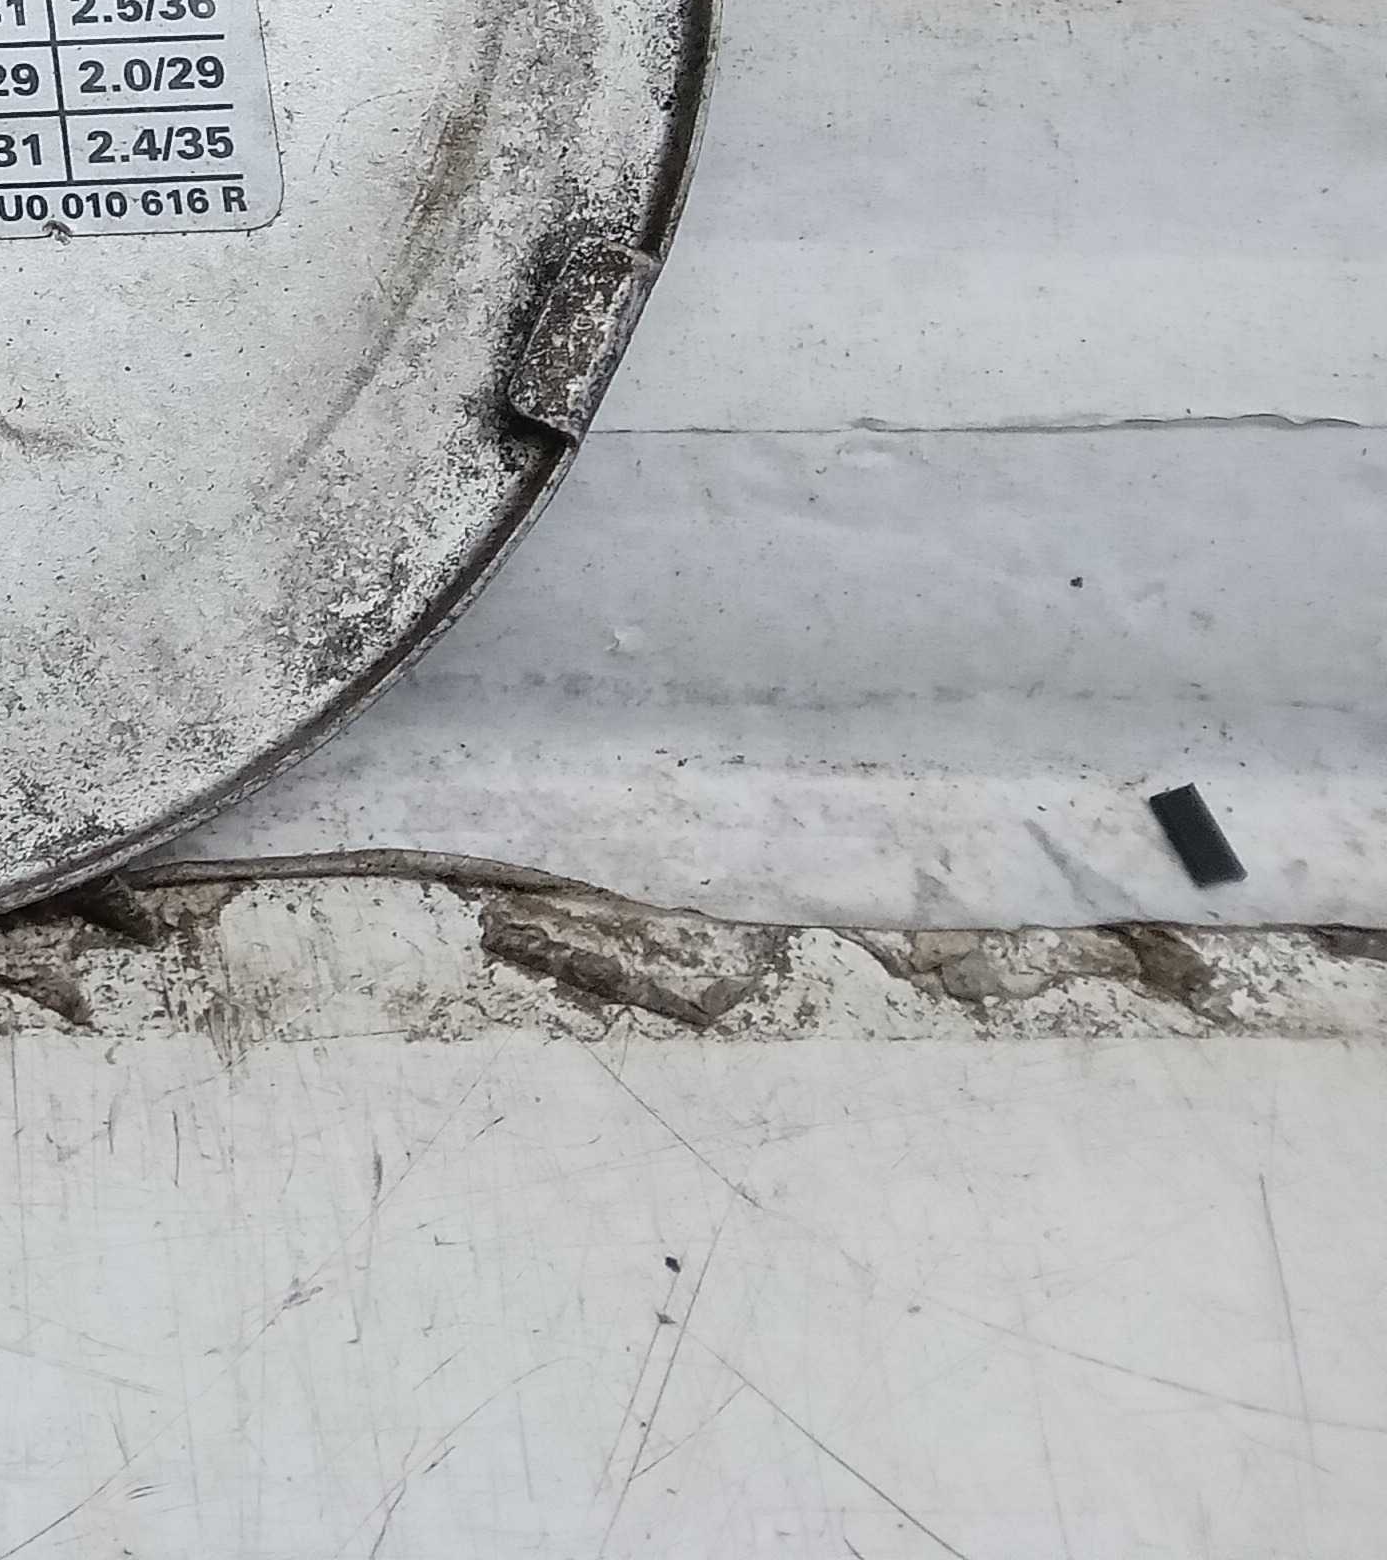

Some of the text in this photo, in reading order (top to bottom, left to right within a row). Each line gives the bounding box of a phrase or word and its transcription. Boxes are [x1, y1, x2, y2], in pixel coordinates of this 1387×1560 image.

[79, 56, 225, 93] 2.0/29
[87, 126, 234, 163] 2.4/35
[63, 191, 128, 219] 010
[142, 188, 209, 216] 616
[223, 186, 248, 213] R
